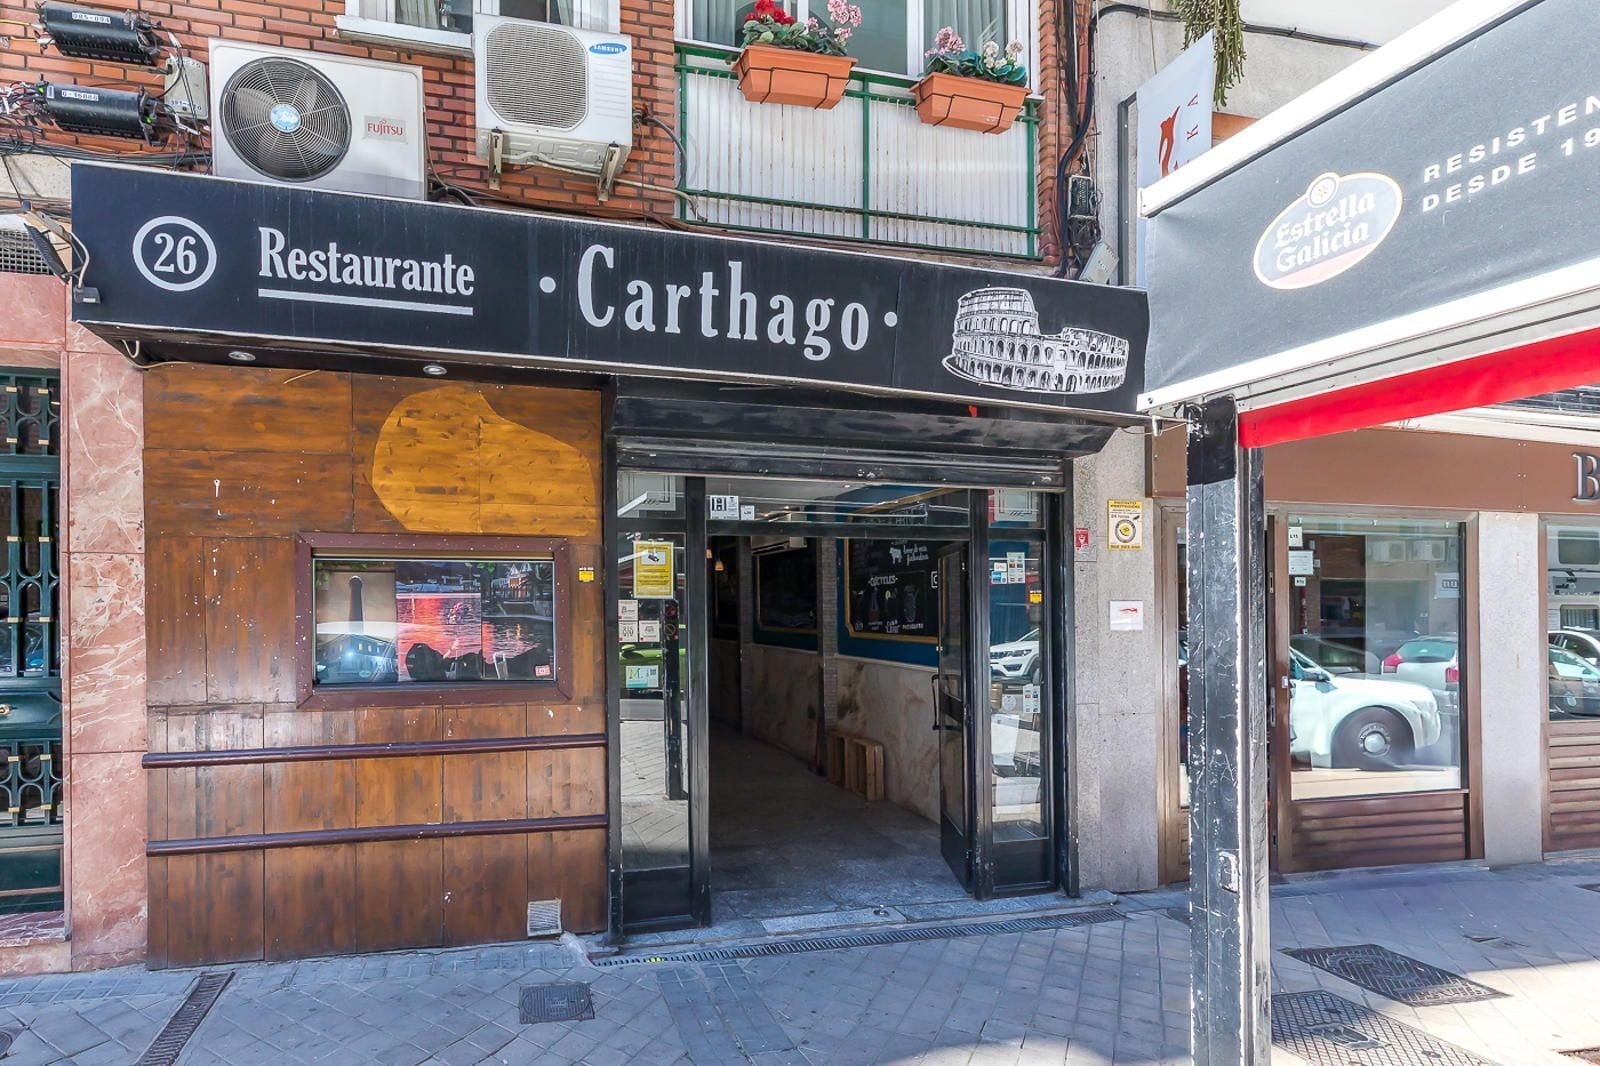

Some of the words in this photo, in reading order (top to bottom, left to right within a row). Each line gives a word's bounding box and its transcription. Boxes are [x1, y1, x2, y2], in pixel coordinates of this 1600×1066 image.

[367, 119, 403, 136] FUJITSU
[1422, 153, 1537, 212] DESDE
[1274, 192, 1376, 249] Estrella
[1276, 221, 1370, 273] Galicia
[153, 232, 197, 275] 26
[258, 226, 475, 297] Restaurante
[577, 244, 870, 362] Carthago
